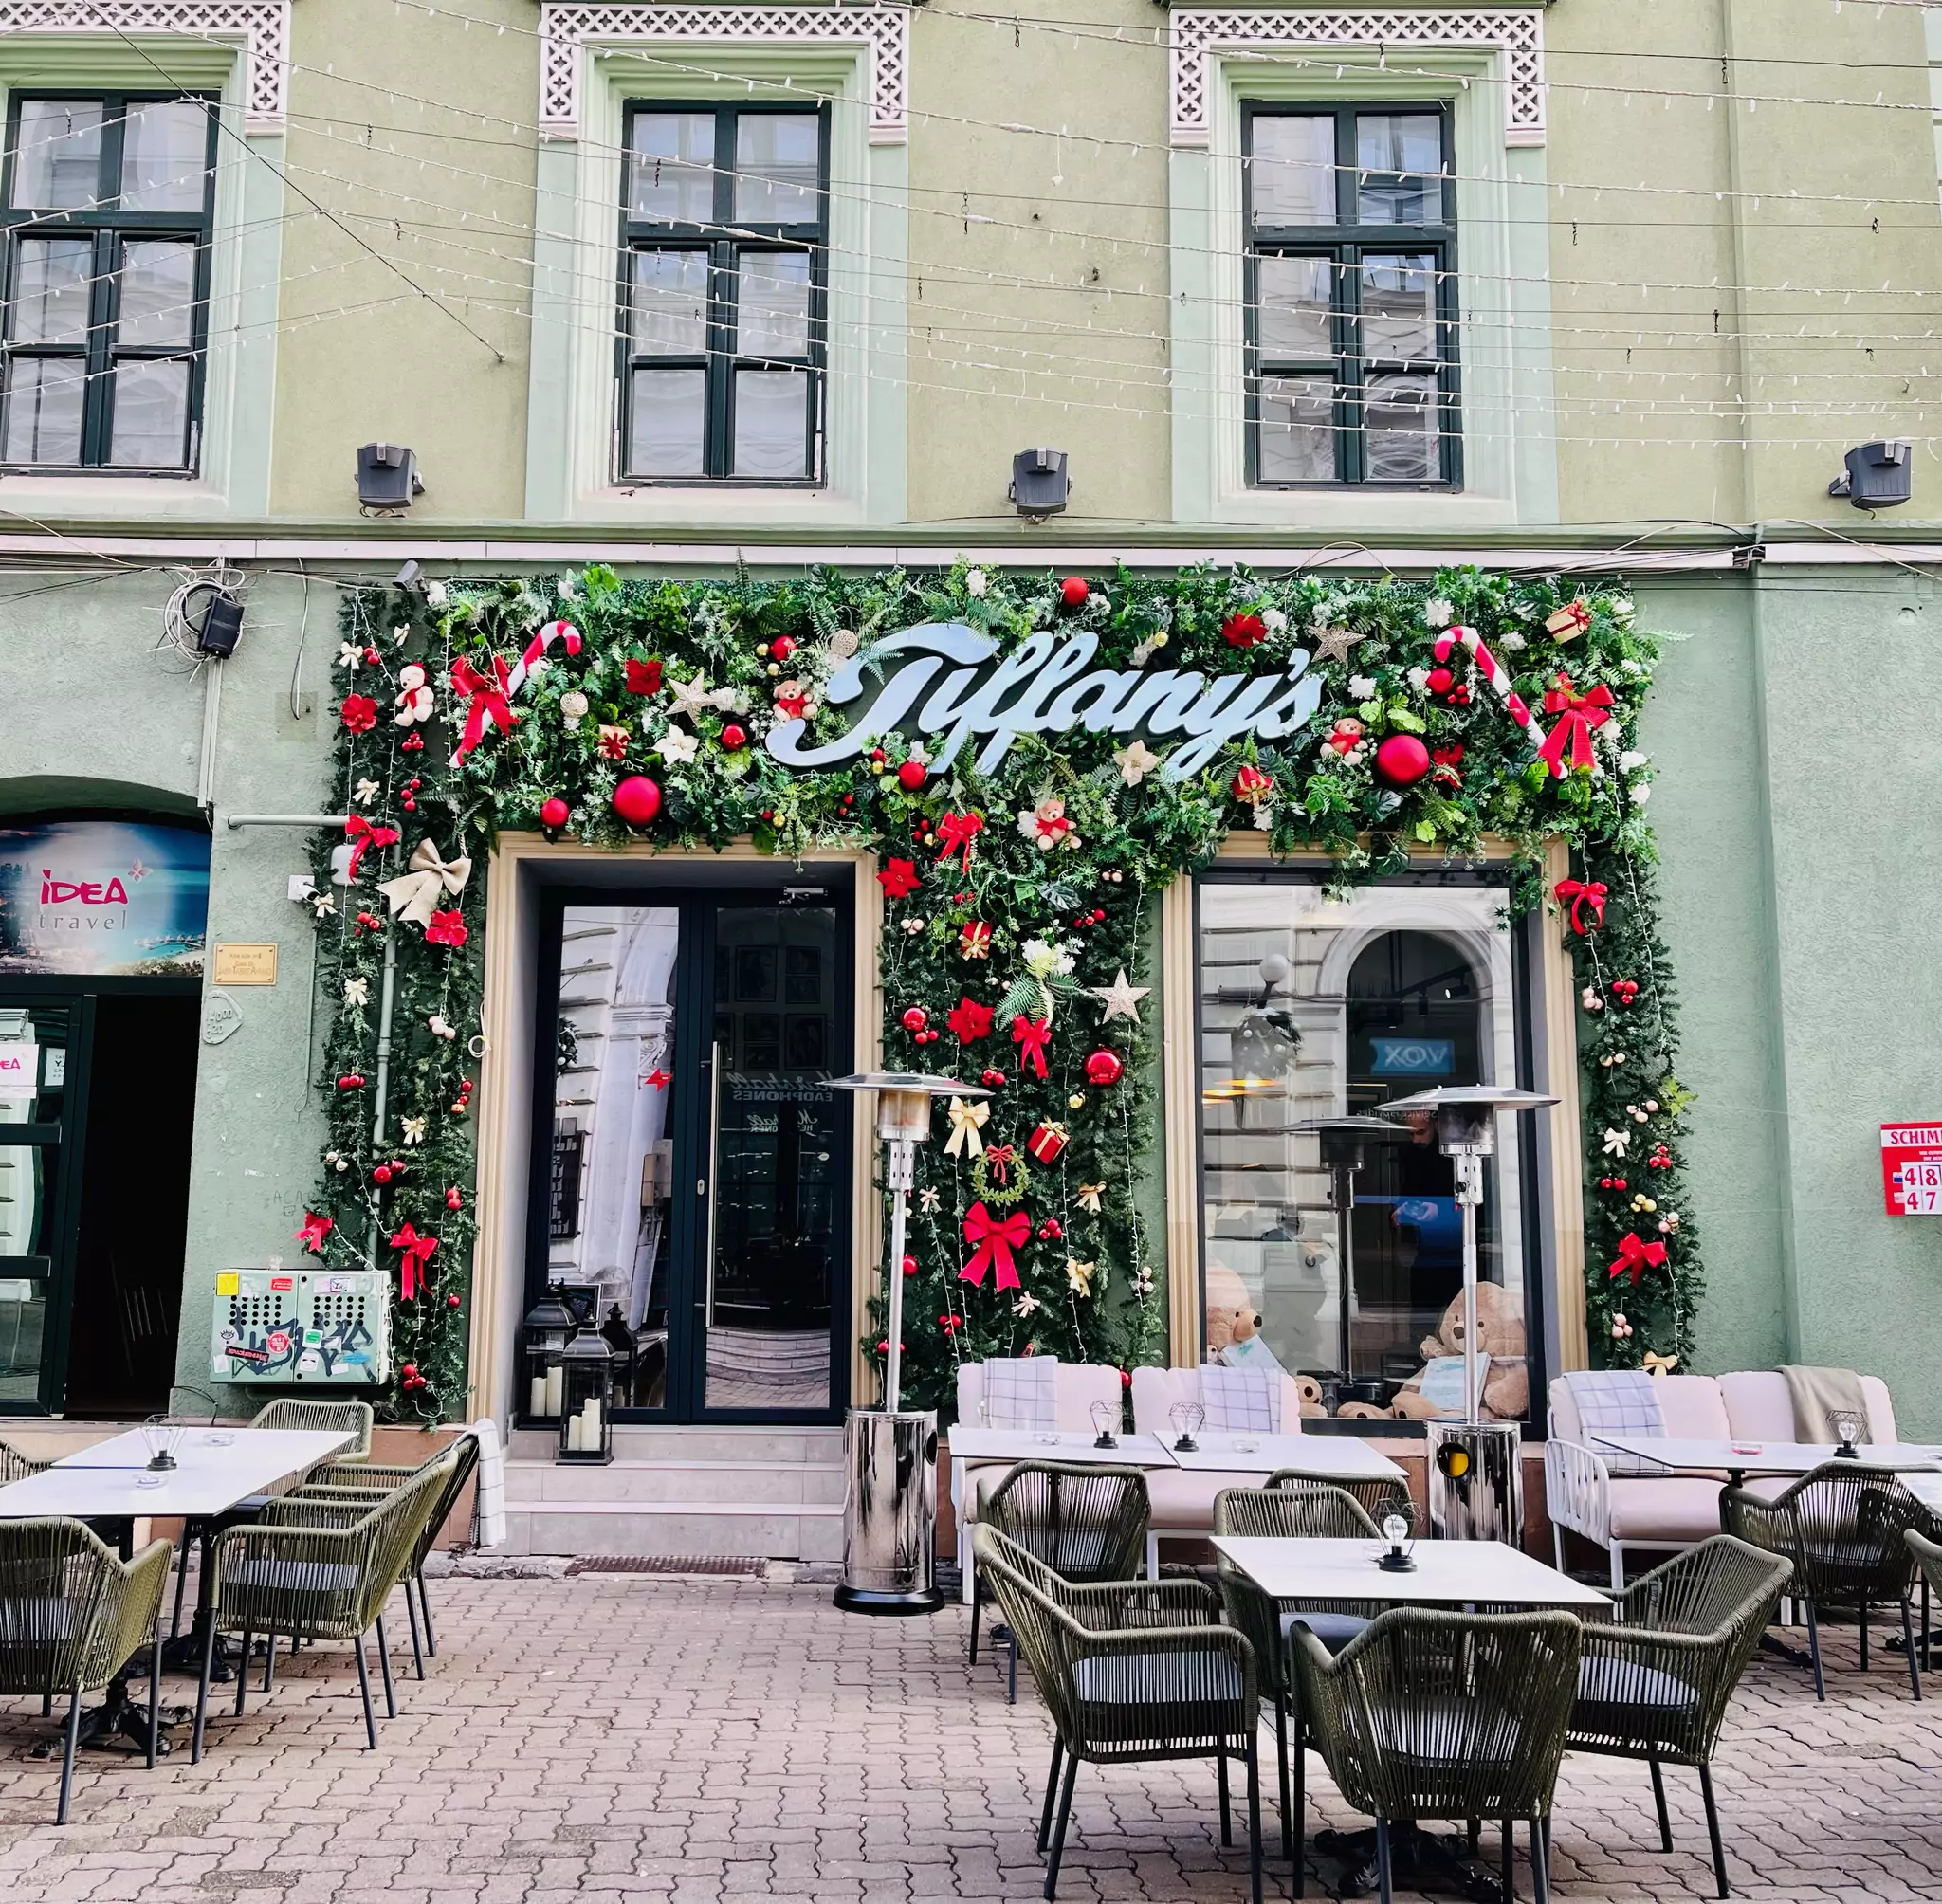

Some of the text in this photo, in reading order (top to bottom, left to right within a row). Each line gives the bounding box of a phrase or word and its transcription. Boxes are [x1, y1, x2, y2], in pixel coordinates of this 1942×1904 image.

[39, 910, 127, 930] travel
[0, 1058, 21, 1070] EA
[1890, 1130, 1942, 1144] SCHIM
